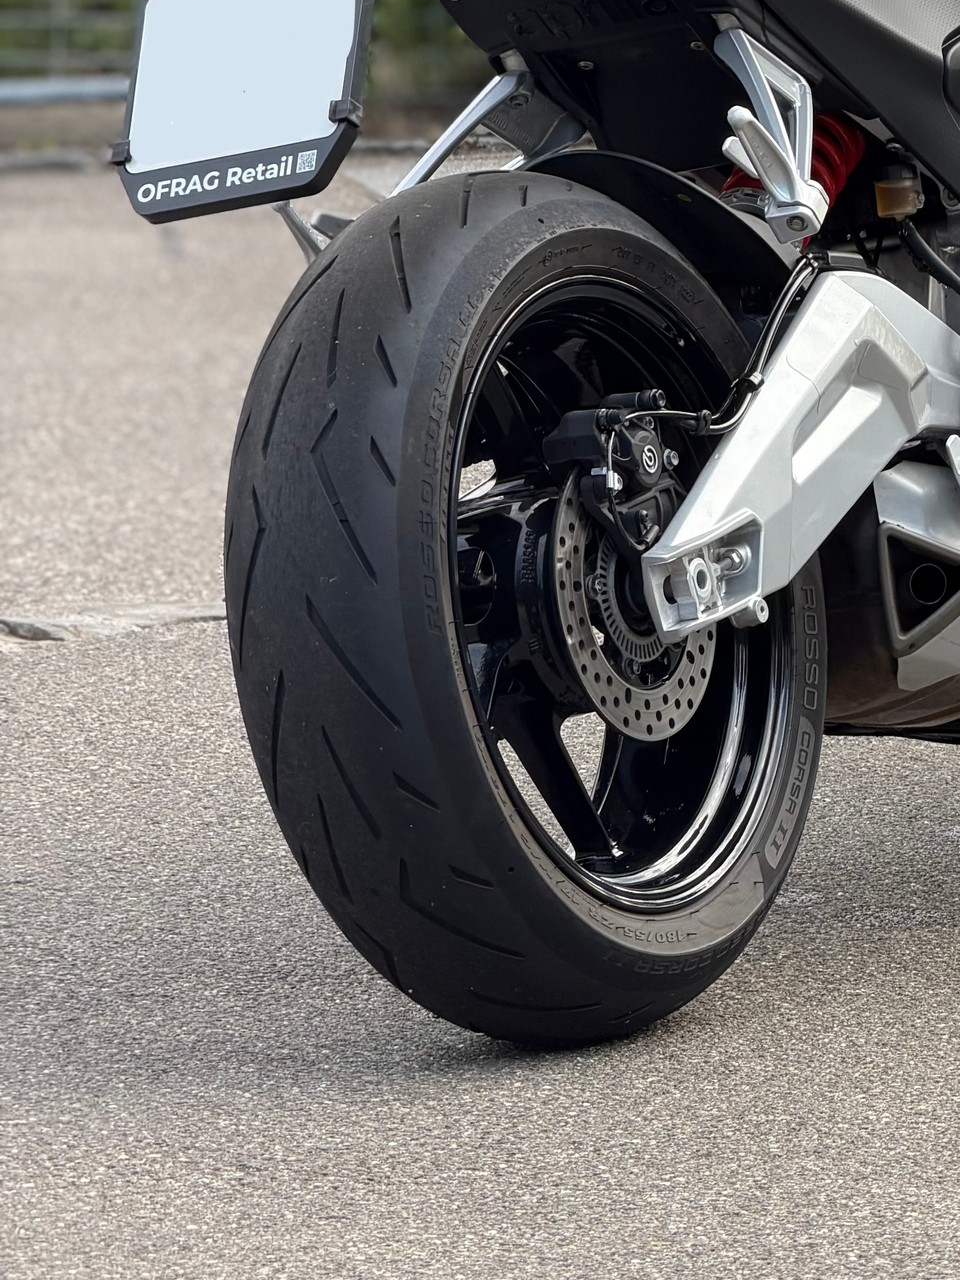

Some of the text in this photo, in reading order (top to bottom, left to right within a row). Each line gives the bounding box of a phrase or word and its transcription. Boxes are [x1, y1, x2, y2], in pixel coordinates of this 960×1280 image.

[137, 156, 294, 203] OFRAG Retail
[801, 586, 820, 711] ROSSO
[785, 730, 811, 815] CORSA
